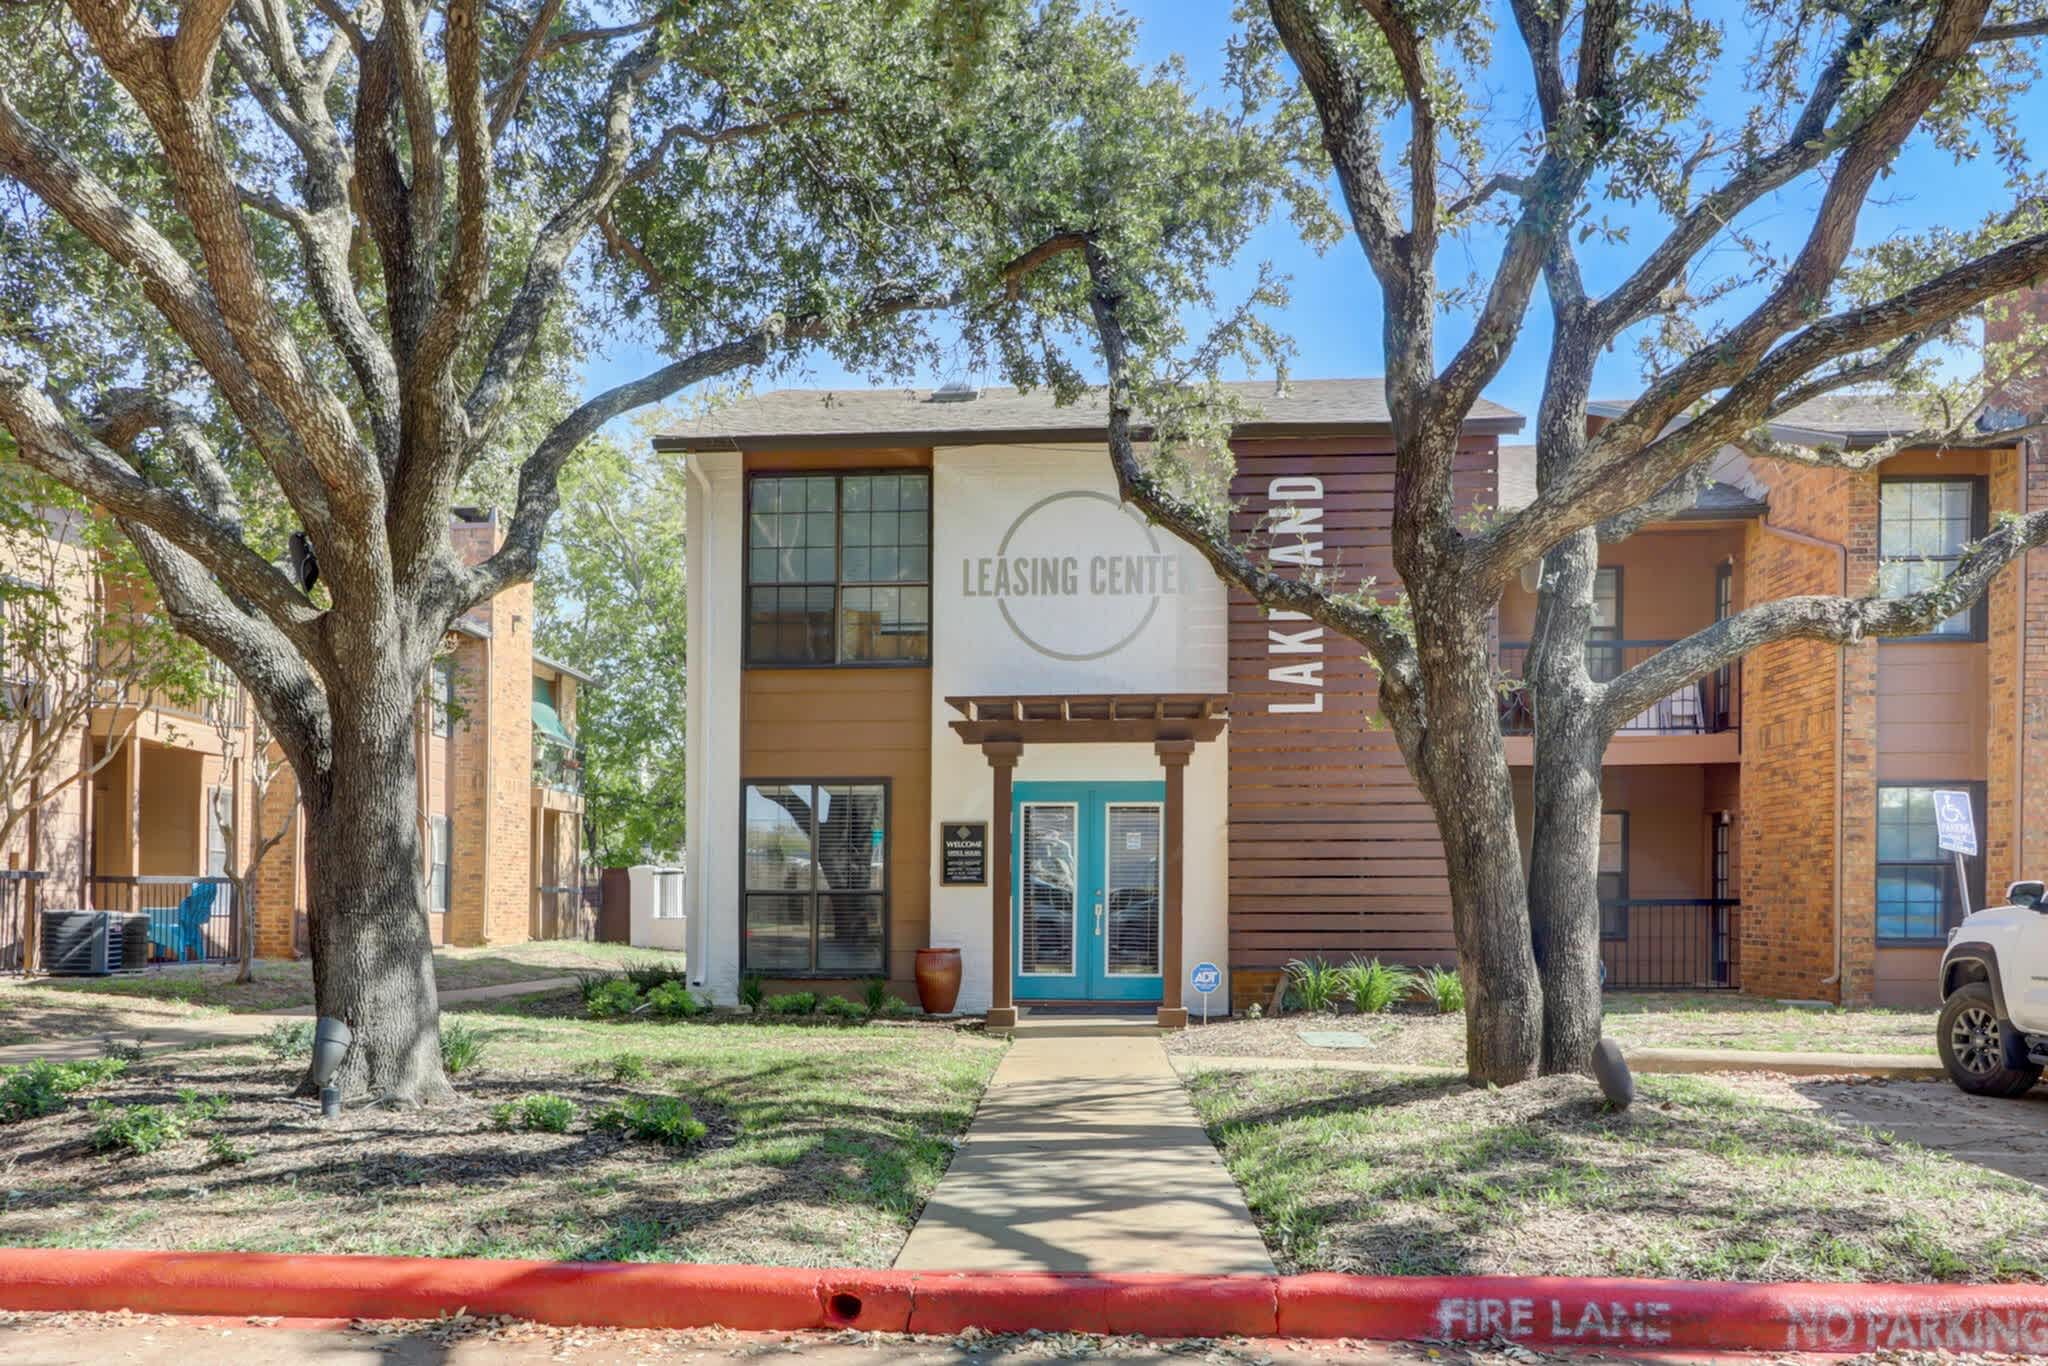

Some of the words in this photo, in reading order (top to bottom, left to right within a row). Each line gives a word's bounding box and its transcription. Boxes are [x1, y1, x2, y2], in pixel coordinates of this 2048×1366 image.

[962, 557, 1078, 596] LEASING
[1268, 476, 1323, 713] LAKAND
[946, 840, 983, 848] WELCOME
[1195, 971, 1218, 983] ADT
[1435, 1298, 1534, 1338] FIRE
[1550, 1300, 1672, 1340] LANE
[1785, 1302, 1856, 1350] NO
[1865, 1303, 2048, 1350] PARKING
